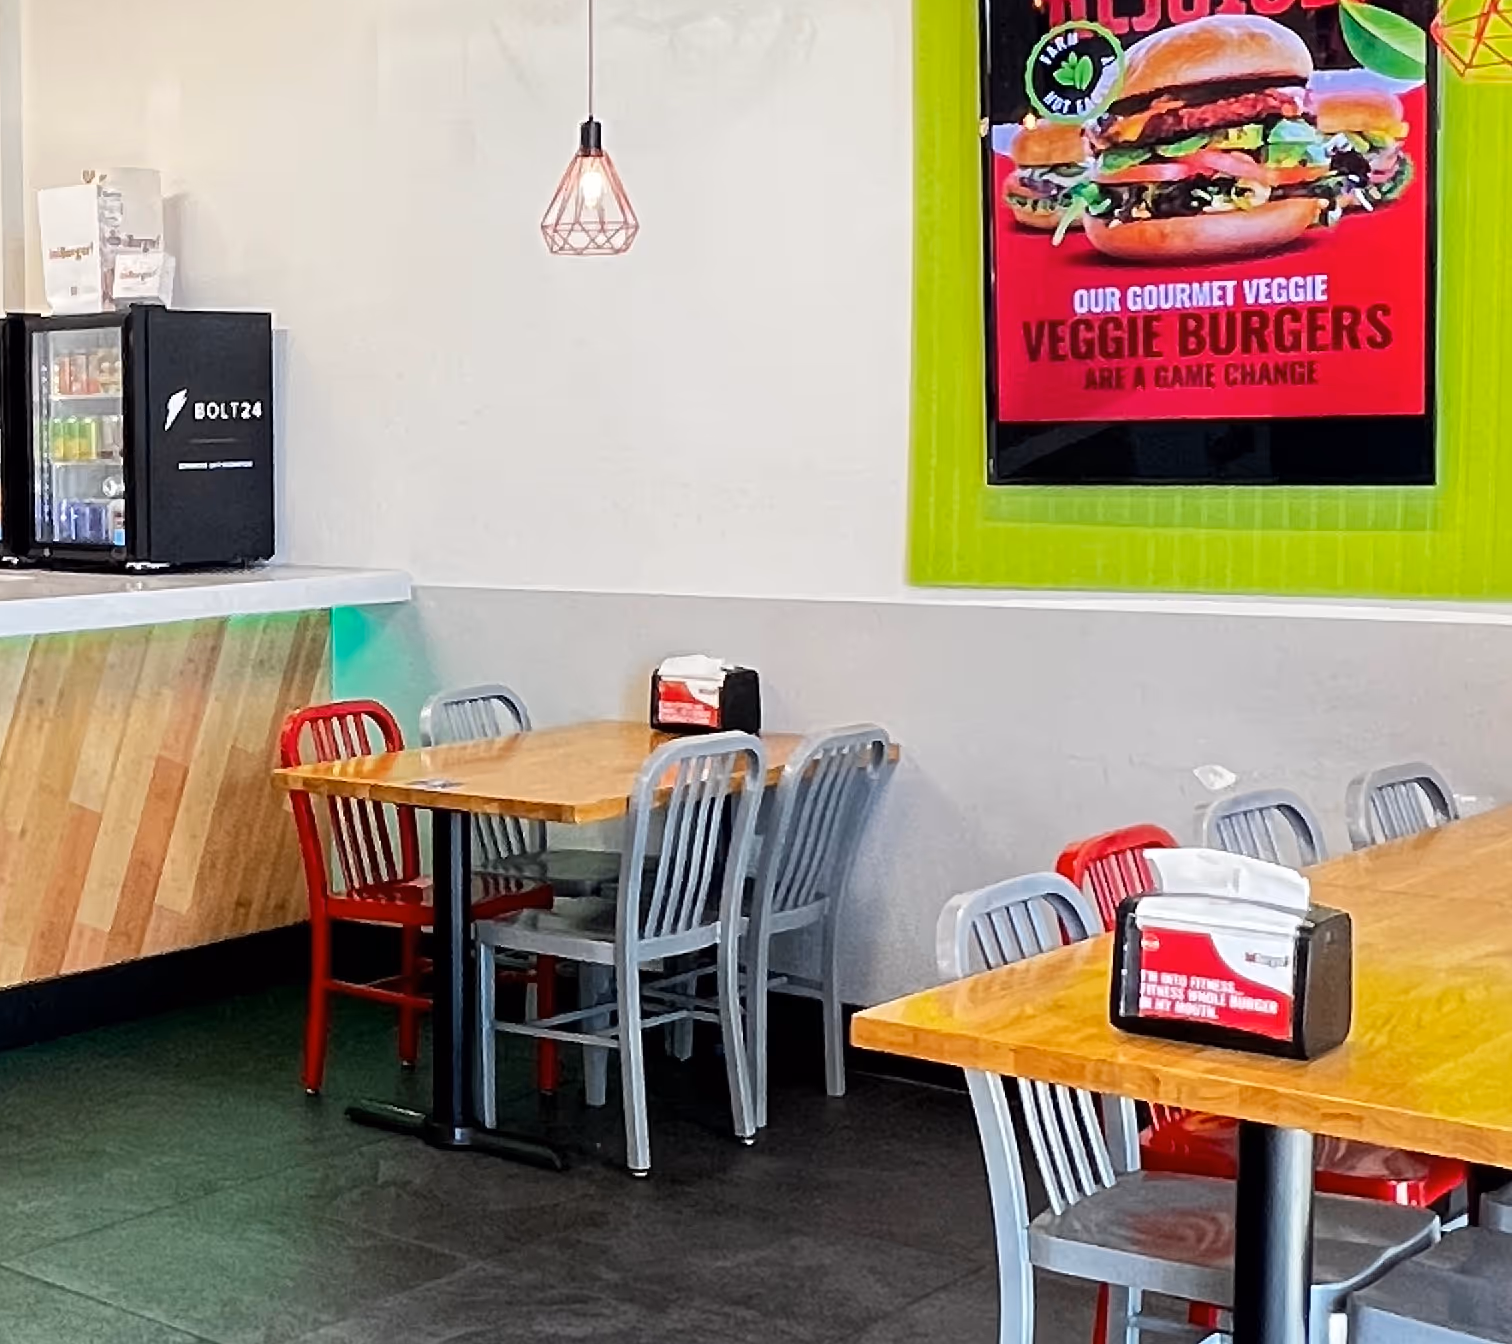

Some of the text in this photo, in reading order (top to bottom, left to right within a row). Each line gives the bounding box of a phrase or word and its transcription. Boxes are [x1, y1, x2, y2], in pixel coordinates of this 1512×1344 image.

[1073, 274, 1329, 316] OUR GOURMET VEGGIE
[1021, 302, 1394, 363] VEGGIE BURGERS
[1083, 359, 1320, 392] ARE A GAME CHANGE
[194, 401, 263, 420] BOLT24
